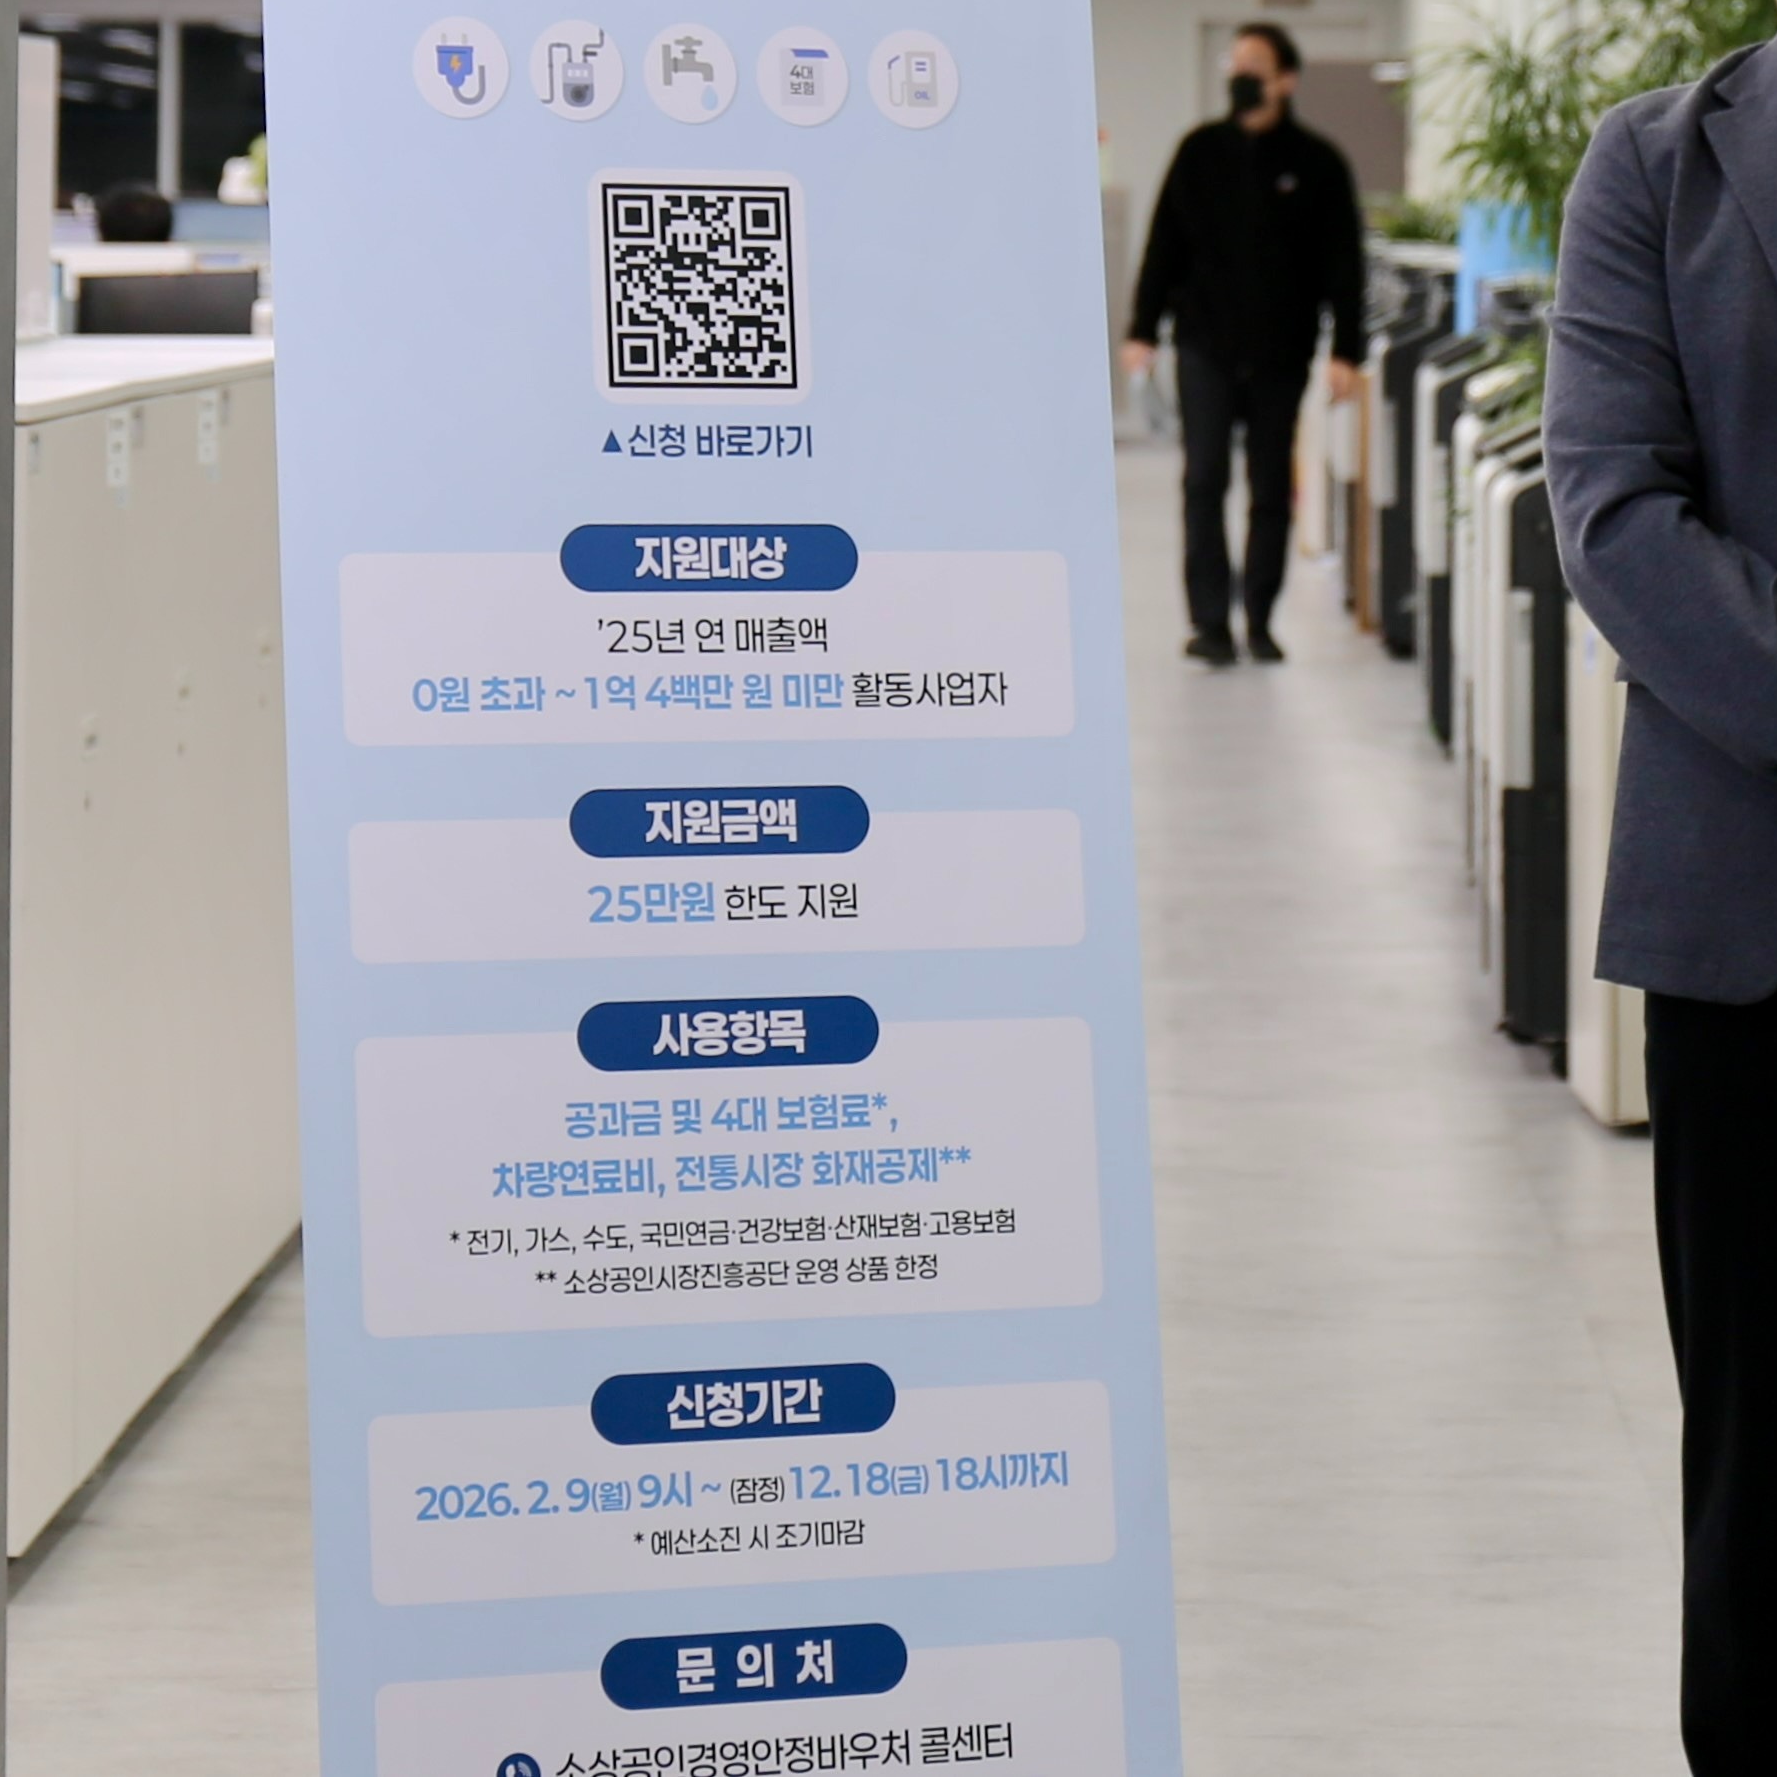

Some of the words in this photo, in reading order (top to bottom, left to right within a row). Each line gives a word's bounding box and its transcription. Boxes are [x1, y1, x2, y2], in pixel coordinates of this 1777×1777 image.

[790, 65, 813, 80] 4대
[790, 81, 815, 96] 보험
[915, 91, 929, 100] OIL
[628, 424, 686, 458] 신청
[695, 424, 813, 459] 바로가기
[634, 537, 787, 581] 지원대상
[694, 618, 725, 653] 연
[734, 617, 828, 653] 매출액
[412, 676, 470, 714] 0원
[479, 676, 545, 714] 초과
[584, 674, 636, 711] 1억
[645, 672, 732, 711] 4백만
[742, 672, 772, 710] 원
[782, 672, 843, 708] 미만
[852, 671, 1008, 708] 활동사업자
[644, 798, 797, 845] 지원금액
[588, 882, 716, 925] 25만원
[724, 884, 788, 920] 한도
[797, 882, 860, 918] 지원
[653, 1008, 806, 1057] 사용항목
[564, 1099, 661, 1139] 공과금
[672, 1098, 702, 1136] 및
[711, 1097, 766, 1133] 4대
[492, 1159, 665, 1199] 차량연료비,
[675, 1151, 803, 1194] 전통시장
[467, 1228, 517, 1256] 전기,
[525, 1225, 576, 1253] 가스,
[583, 1222, 633, 1253] 수도,
[564, 1258, 789, 1295] 소상공인시장진흥공단
[795, 1256, 838, 1285] 운영
[845, 1255, 889, 1282] 상품
[895, 1254, 939, 1280] 한정
[667, 1379, 822, 1429] 신청기간
[638, 1471, 692, 1508] 9시
[936, 1451, 1069, 1491] 18시까지
[651, 1526, 741, 1556] 예산소진
[749, 1524, 769, 1550] 시
[776, 1520, 865, 1547] 조기마감
[920, 1723, 1013, 1763] 콜센터
